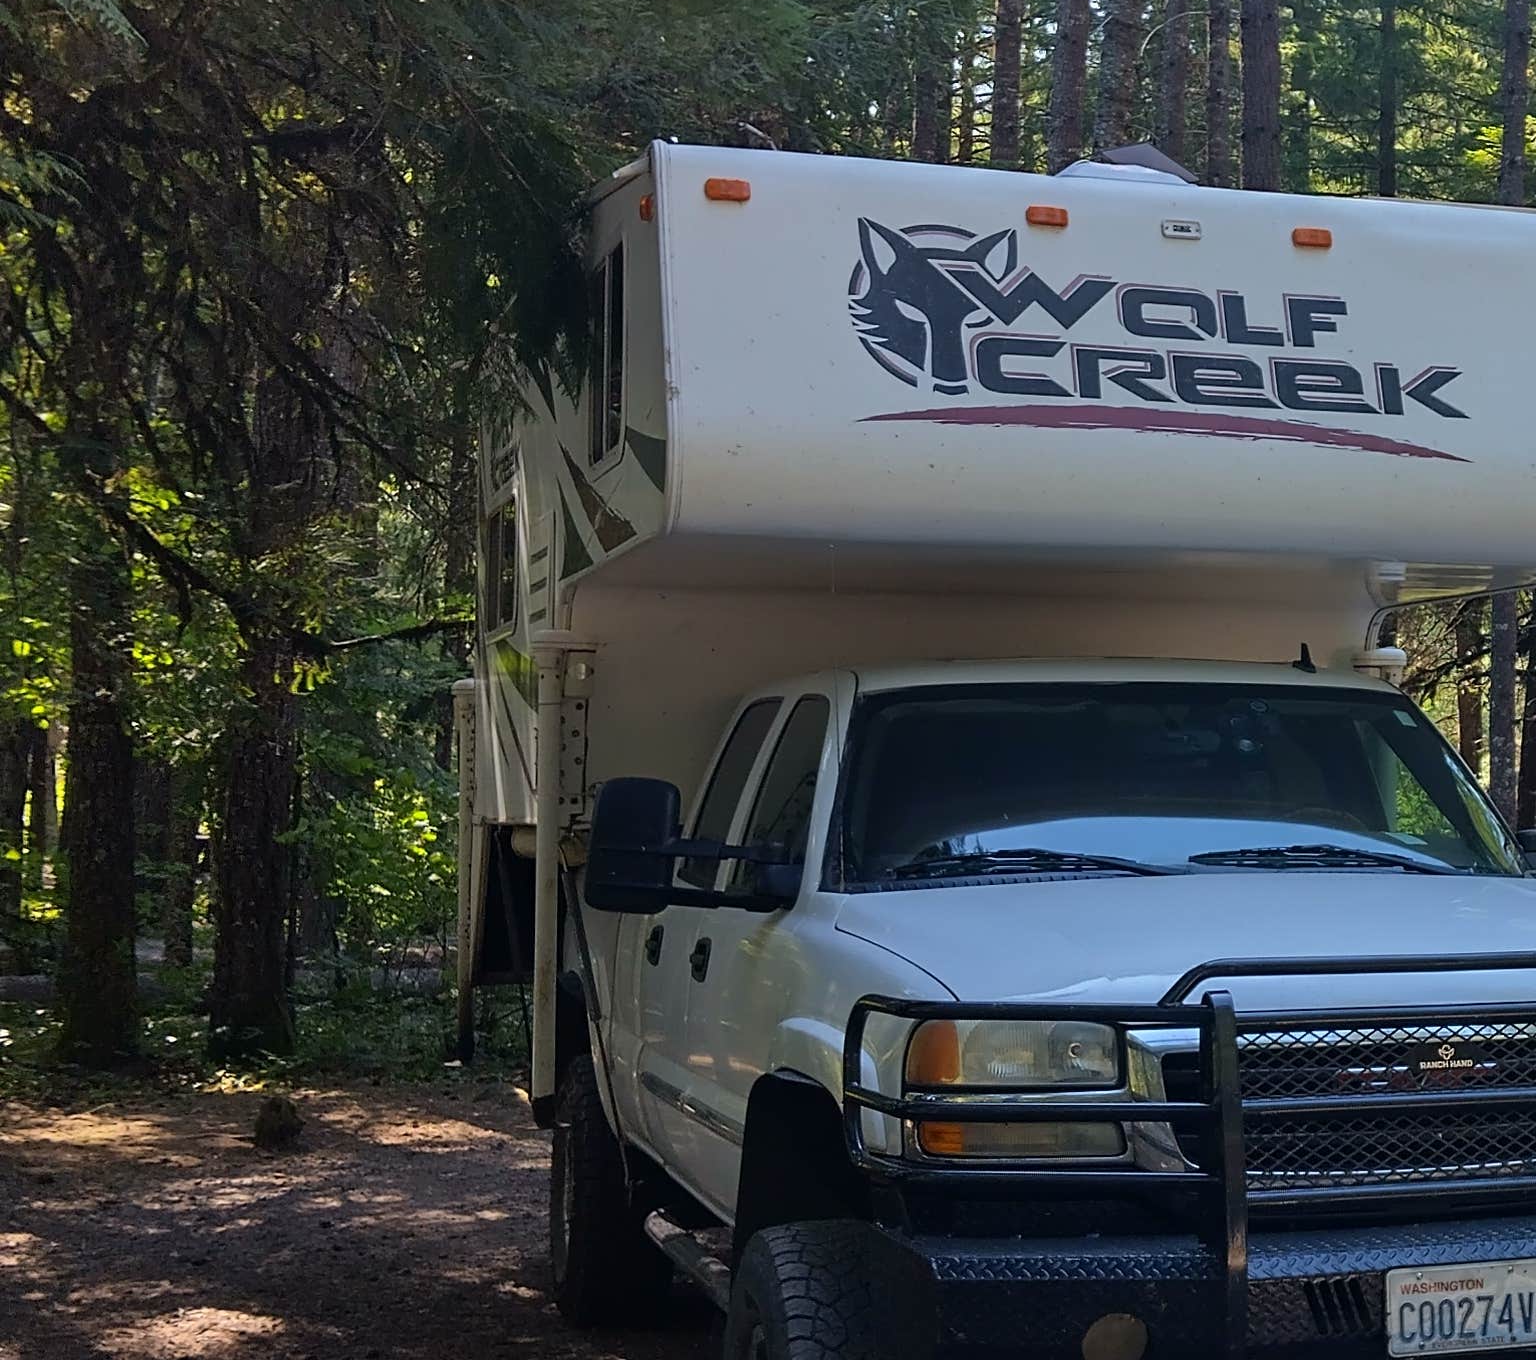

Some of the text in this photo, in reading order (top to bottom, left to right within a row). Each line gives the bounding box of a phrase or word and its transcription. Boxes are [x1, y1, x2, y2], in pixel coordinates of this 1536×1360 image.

[933, 263, 1348, 348] WOLF
[1419, 1059, 1474, 1070] RANCH HAND
[1400, 1278, 1485, 1295] WASHINGTON
